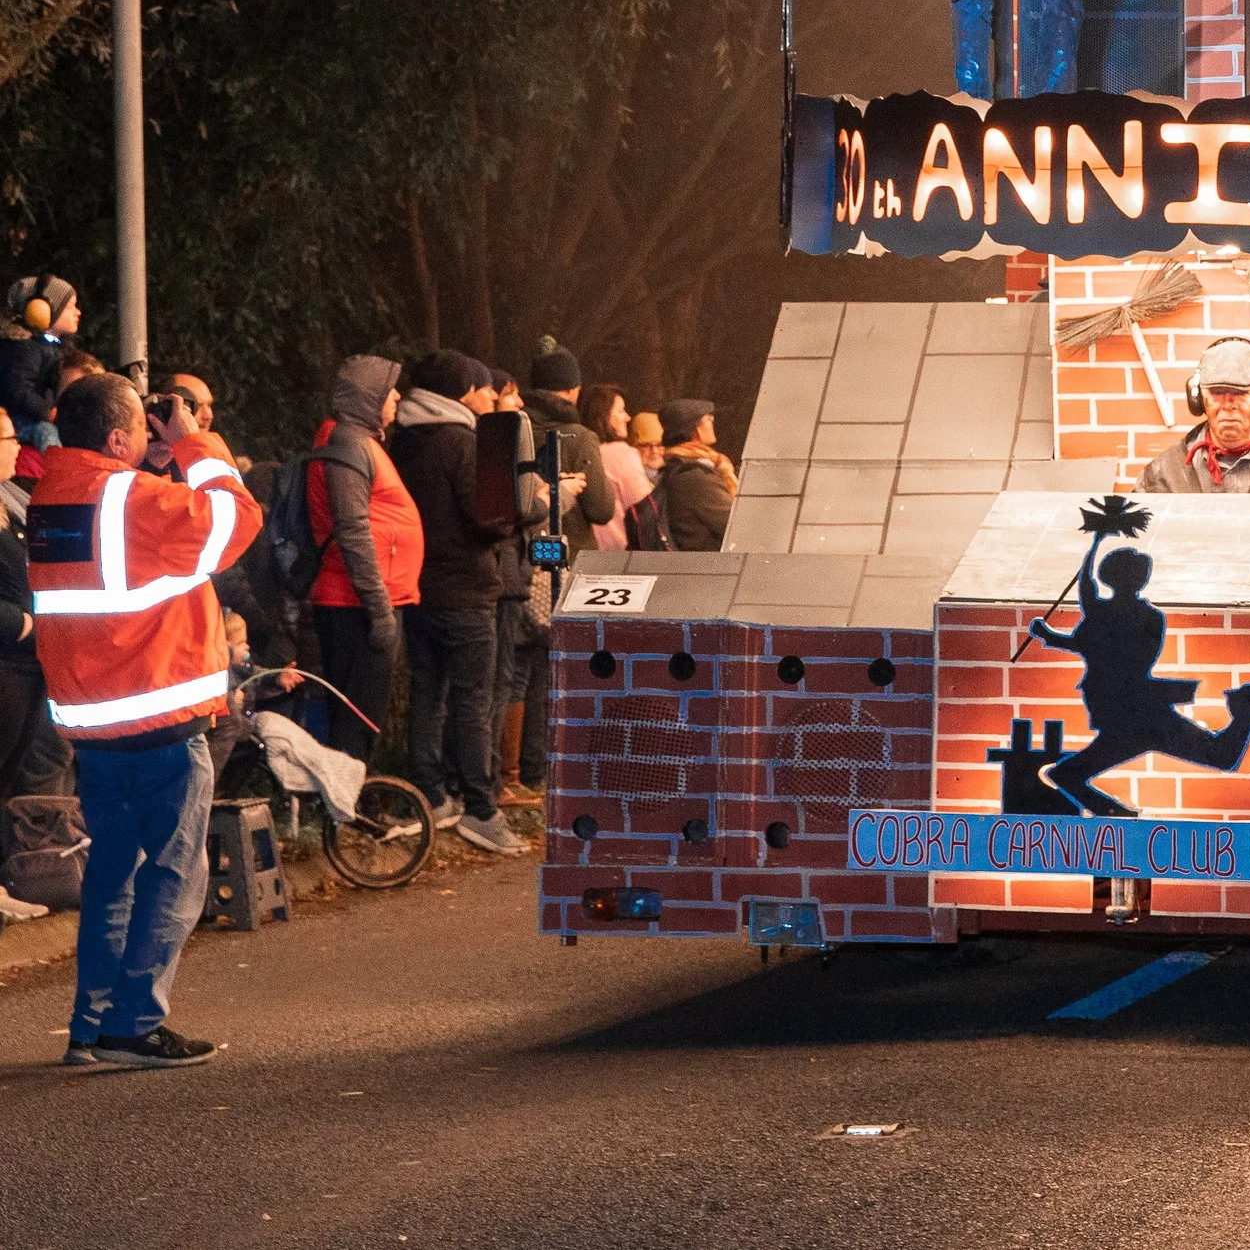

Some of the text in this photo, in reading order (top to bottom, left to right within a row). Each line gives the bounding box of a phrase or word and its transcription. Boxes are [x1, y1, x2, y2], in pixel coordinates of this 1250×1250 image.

[583, 588, 632, 606] 23
[851, 811, 970, 867] COBRA
[987, 818, 1139, 874] CARNIVAL
